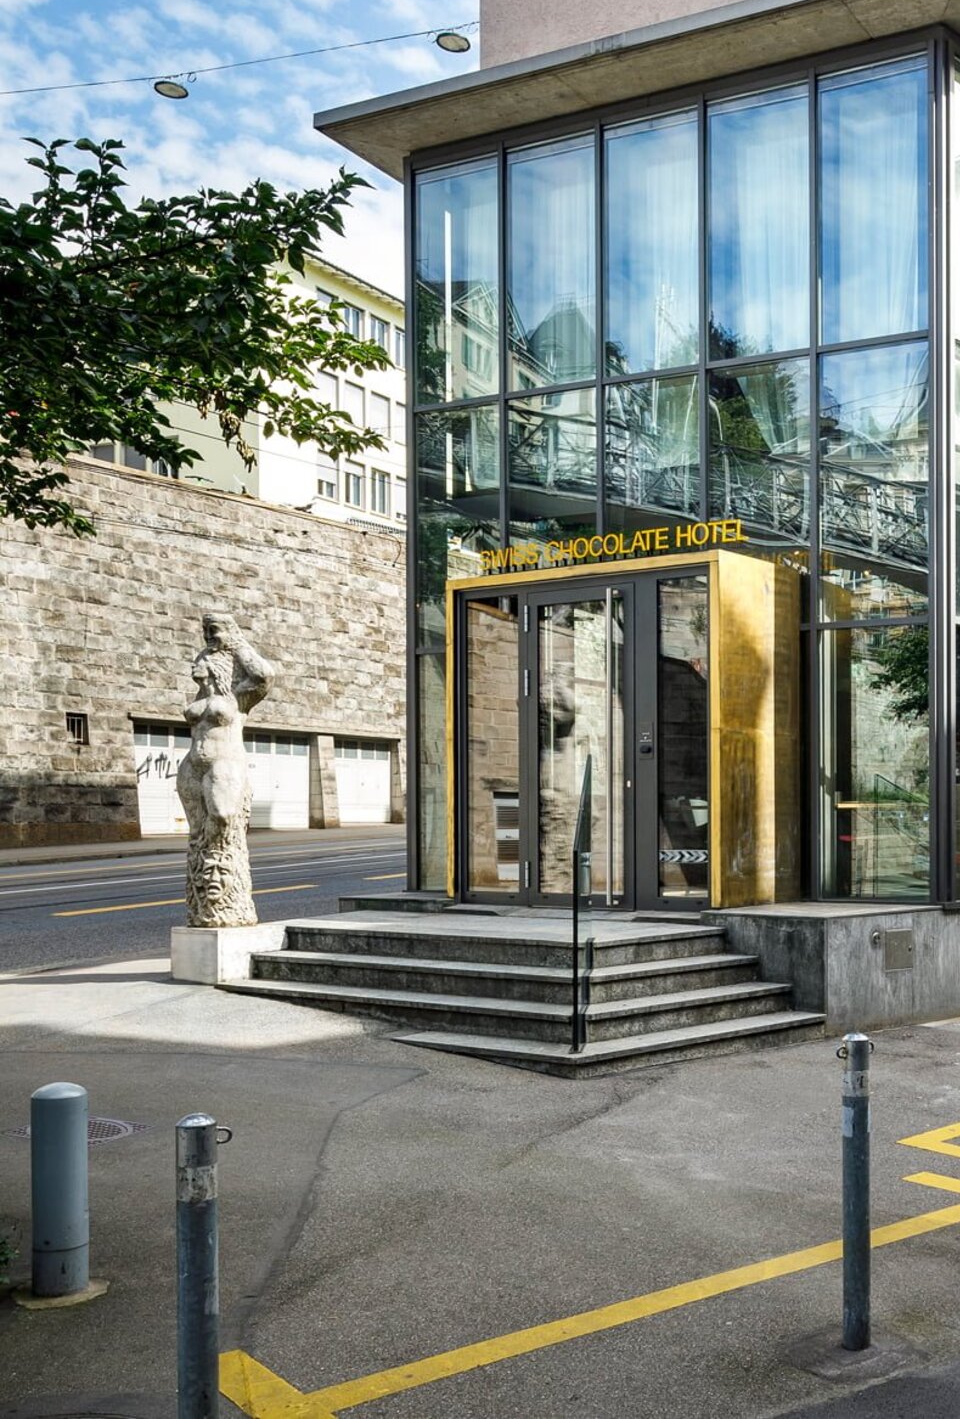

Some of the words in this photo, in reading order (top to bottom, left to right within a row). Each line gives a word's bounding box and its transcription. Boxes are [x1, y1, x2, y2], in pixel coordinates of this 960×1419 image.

[479, 544, 538, 571] SWISS
[546, 526, 670, 563] CHOCOLATE
[676, 519, 748, 548] HOTEL
